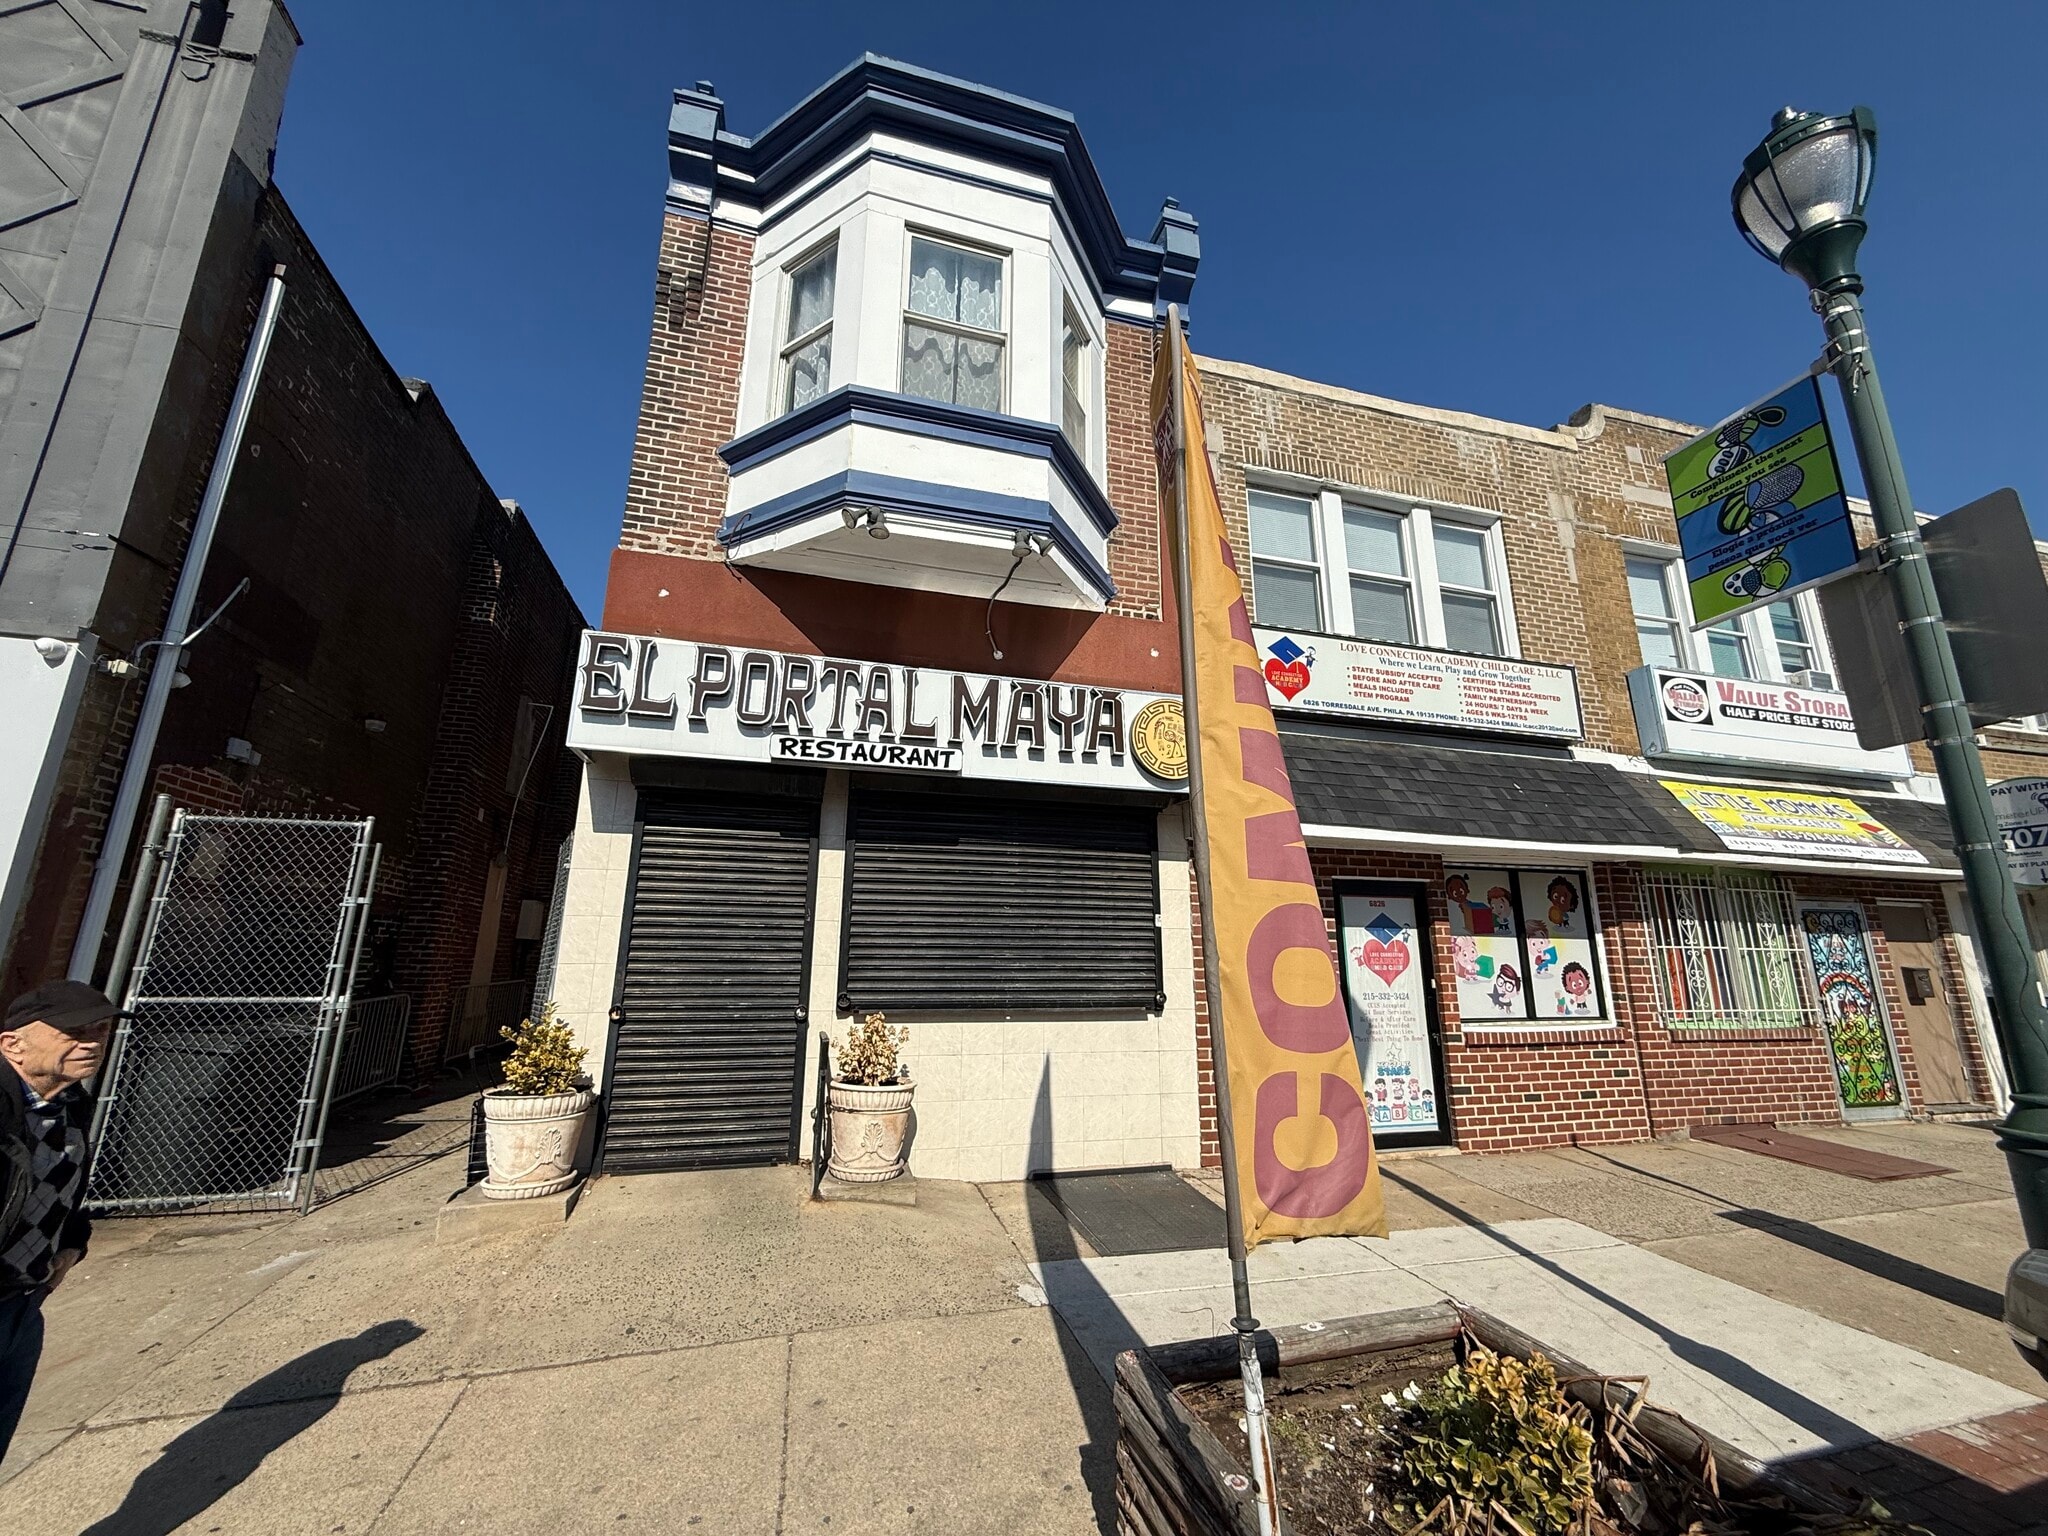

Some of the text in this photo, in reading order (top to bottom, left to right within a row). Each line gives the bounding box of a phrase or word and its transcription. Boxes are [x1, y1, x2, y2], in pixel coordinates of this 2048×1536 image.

[1690, 436, 1803, 499] Compliment the next
[1707, 456, 1787, 502] person you see
[1707, 518, 1818, 573] pessoa que você ver
[1711, 541, 1745, 559] Elogie
[1747, 535, 1755, 543] a
[1340, 642, 1563, 679] LOVE CONNECTION ACADEMY CHILD CARE 2, LLC
[1271, 675, 1304, 683] ACADEMY
[1351, 666, 1443, 682] STATE SUBSIDY ACCEPTED
[1379, 657, 1405, 668] Where
[1419, 662, 1444, 673] Learn,
[1445, 665, 1461, 676] Play
[1462, 668, 1477, 677] and
[1478, 669, 1499, 679] Grow
[1501, 672, 1531, 684] Together
[1352, 674, 1381, 682] BEFORE
[1399, 680, 1421, 688] AFTER
[1422, 682, 1441, 690] CARE
[1353, 682, 1414, 695] MEALS INCLUDED
[1462, 676, 1532, 690] CERTIFIED TEACHERS
[579, 633, 1127, 757] EL PORTAL MAYA
[1375, 693, 1410, 702] PROGRAM
[1463, 685, 1561, 702] KEYSTONE STARS ACCREDITED
[1464, 692, 1538, 707] FAMILY PARTNERSHIPS
[1716, 681, 1849, 718] VALUE STORA
[1321, 701, 1366, 711] TORRESDALE
[1416, 711, 1435, 719] 19135
[1460, 716, 1500, 726] 215-332-3424
[1466, 709, 1484, 717] AGES
[1726, 707, 1855, 731] HALF PRICE SELF STORA
[778, 737, 956, 769] RESTAURANT
[1990, 782, 2048, 796] PAY WITH
[1363, 992, 1410, 1001] 215-332-3424
[1382, 1109, 1420, 1120] A B C
